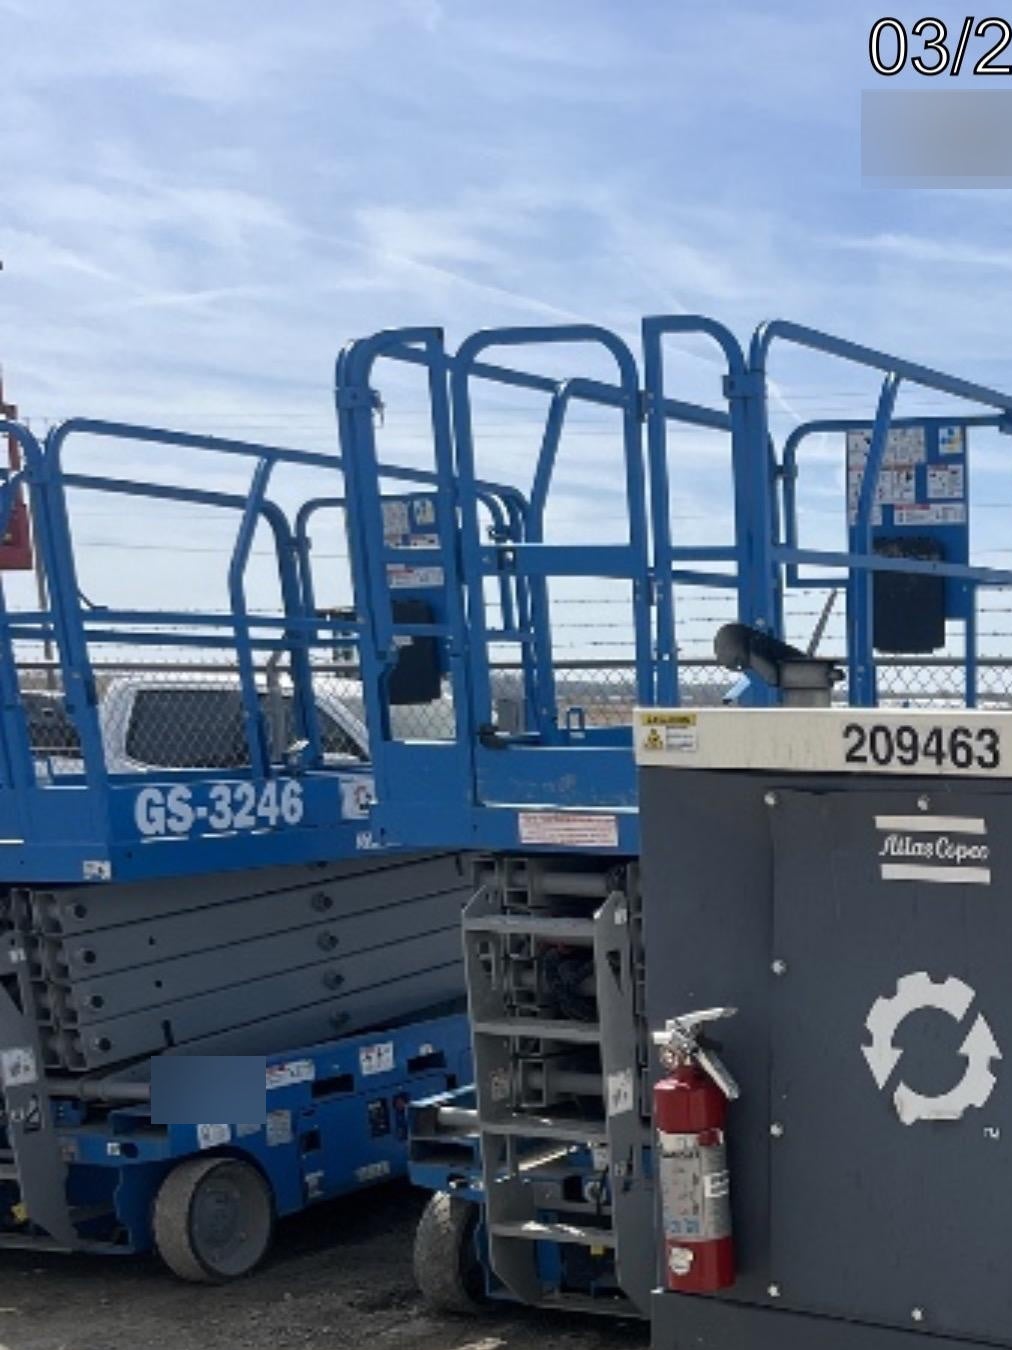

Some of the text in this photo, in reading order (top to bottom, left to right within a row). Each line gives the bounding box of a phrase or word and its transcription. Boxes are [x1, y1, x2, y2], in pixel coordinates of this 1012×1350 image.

[843, 723, 1001, 769] 209463
[134, 778, 304, 836] GS-3246
[878, 834, 990, 864] Atlas Copco
